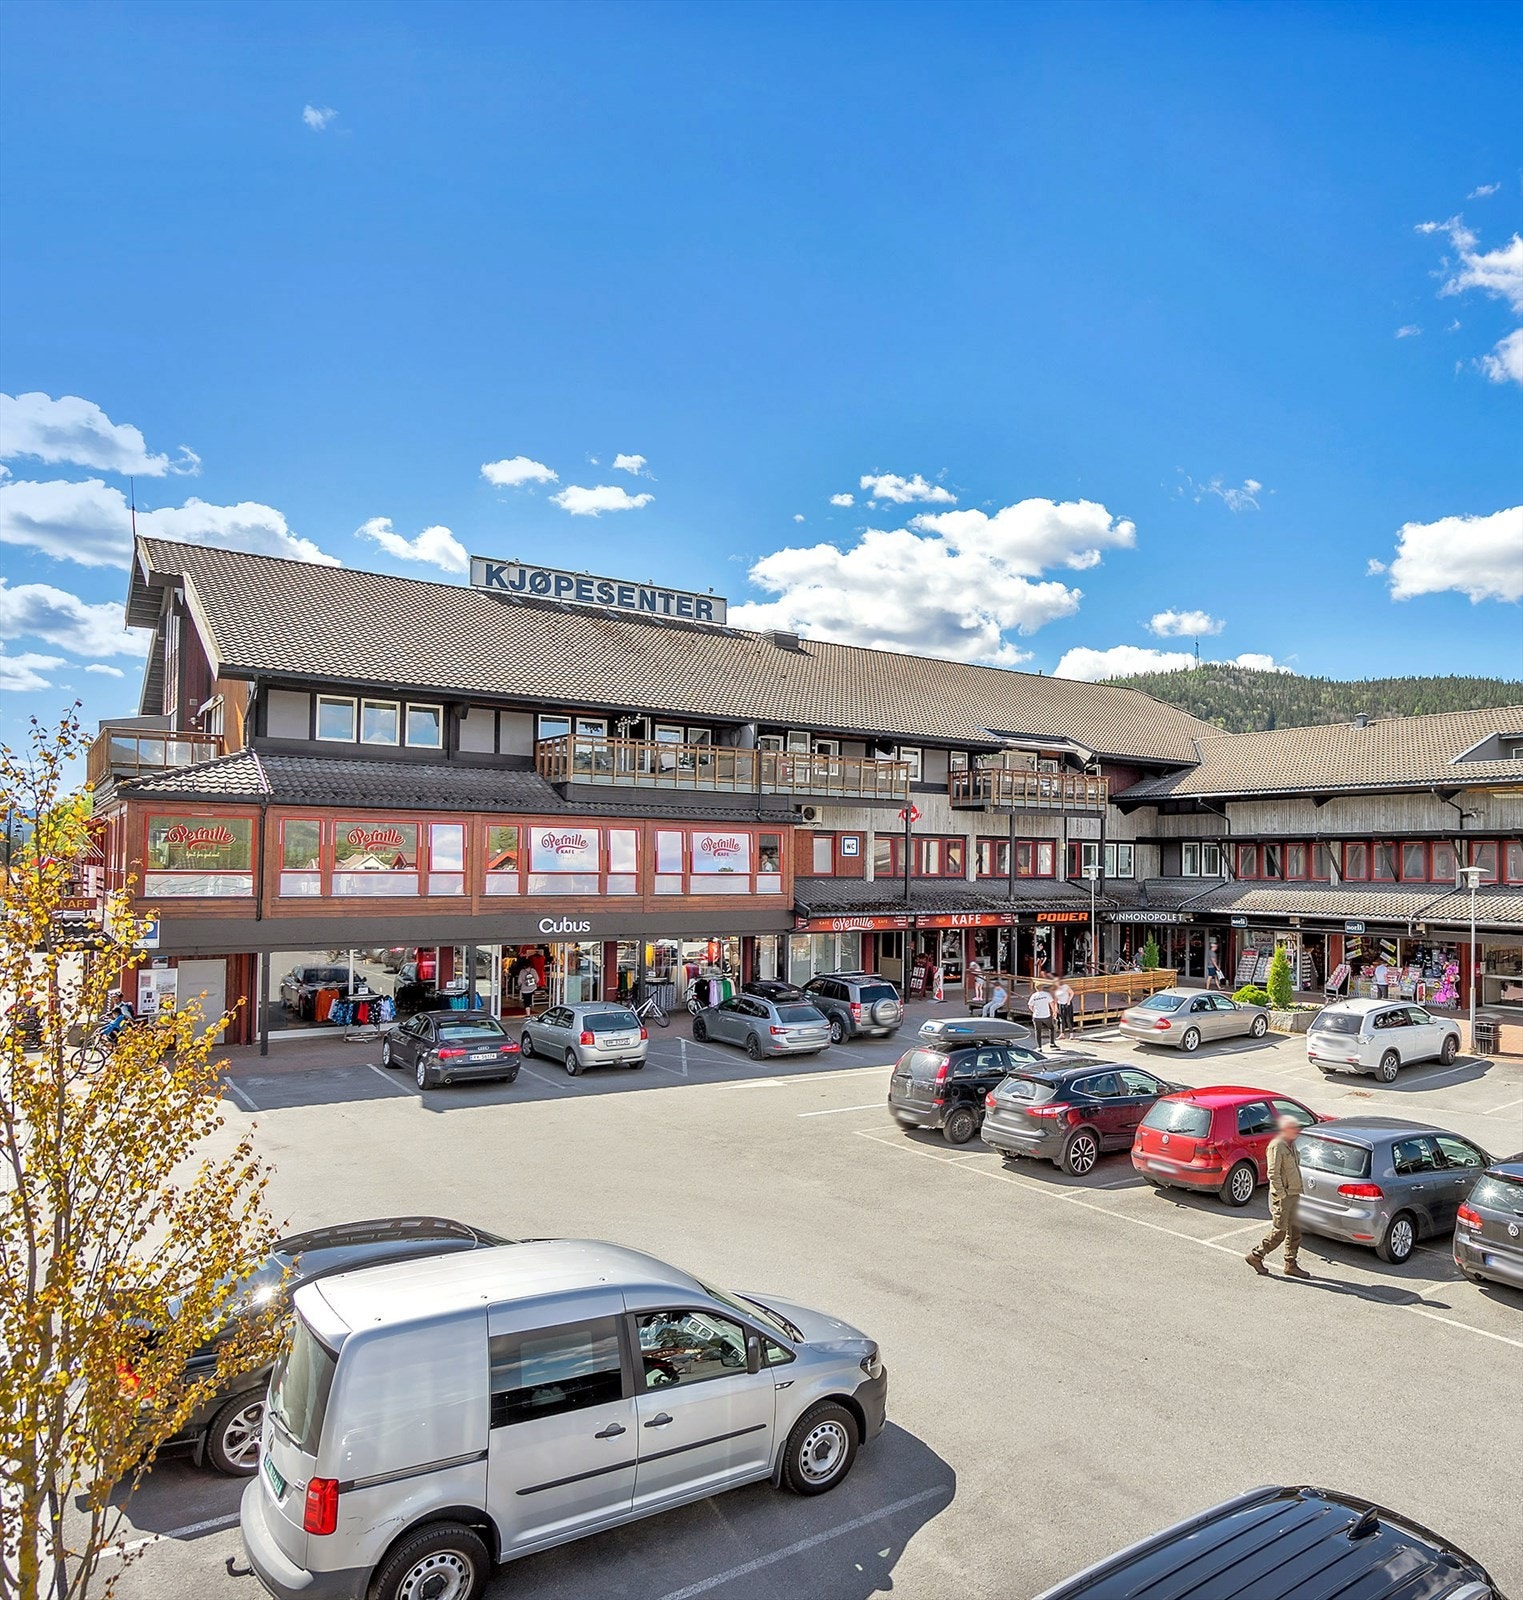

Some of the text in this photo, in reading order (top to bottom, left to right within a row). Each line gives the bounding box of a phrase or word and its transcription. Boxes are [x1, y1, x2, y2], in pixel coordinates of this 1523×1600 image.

[485, 563, 713, 621] KJØPESENTER
[166, 824, 237, 848] Pernille
[347, 826, 406, 849] Pernille
[541, 832, 589, 852] Pernille
[701, 836, 741, 854] Pernille
[59, 900, 89, 908] KAFE
[538, 916, 591, 934] Cubus
[832, 917, 875, 931] Pernille
[951, 914, 981, 925] KAFE
[1036, 912, 1089, 923] POWER
[1109, 913, 1183, 922] VINMONOPOLET
[1346, 923, 1362, 931] norli
